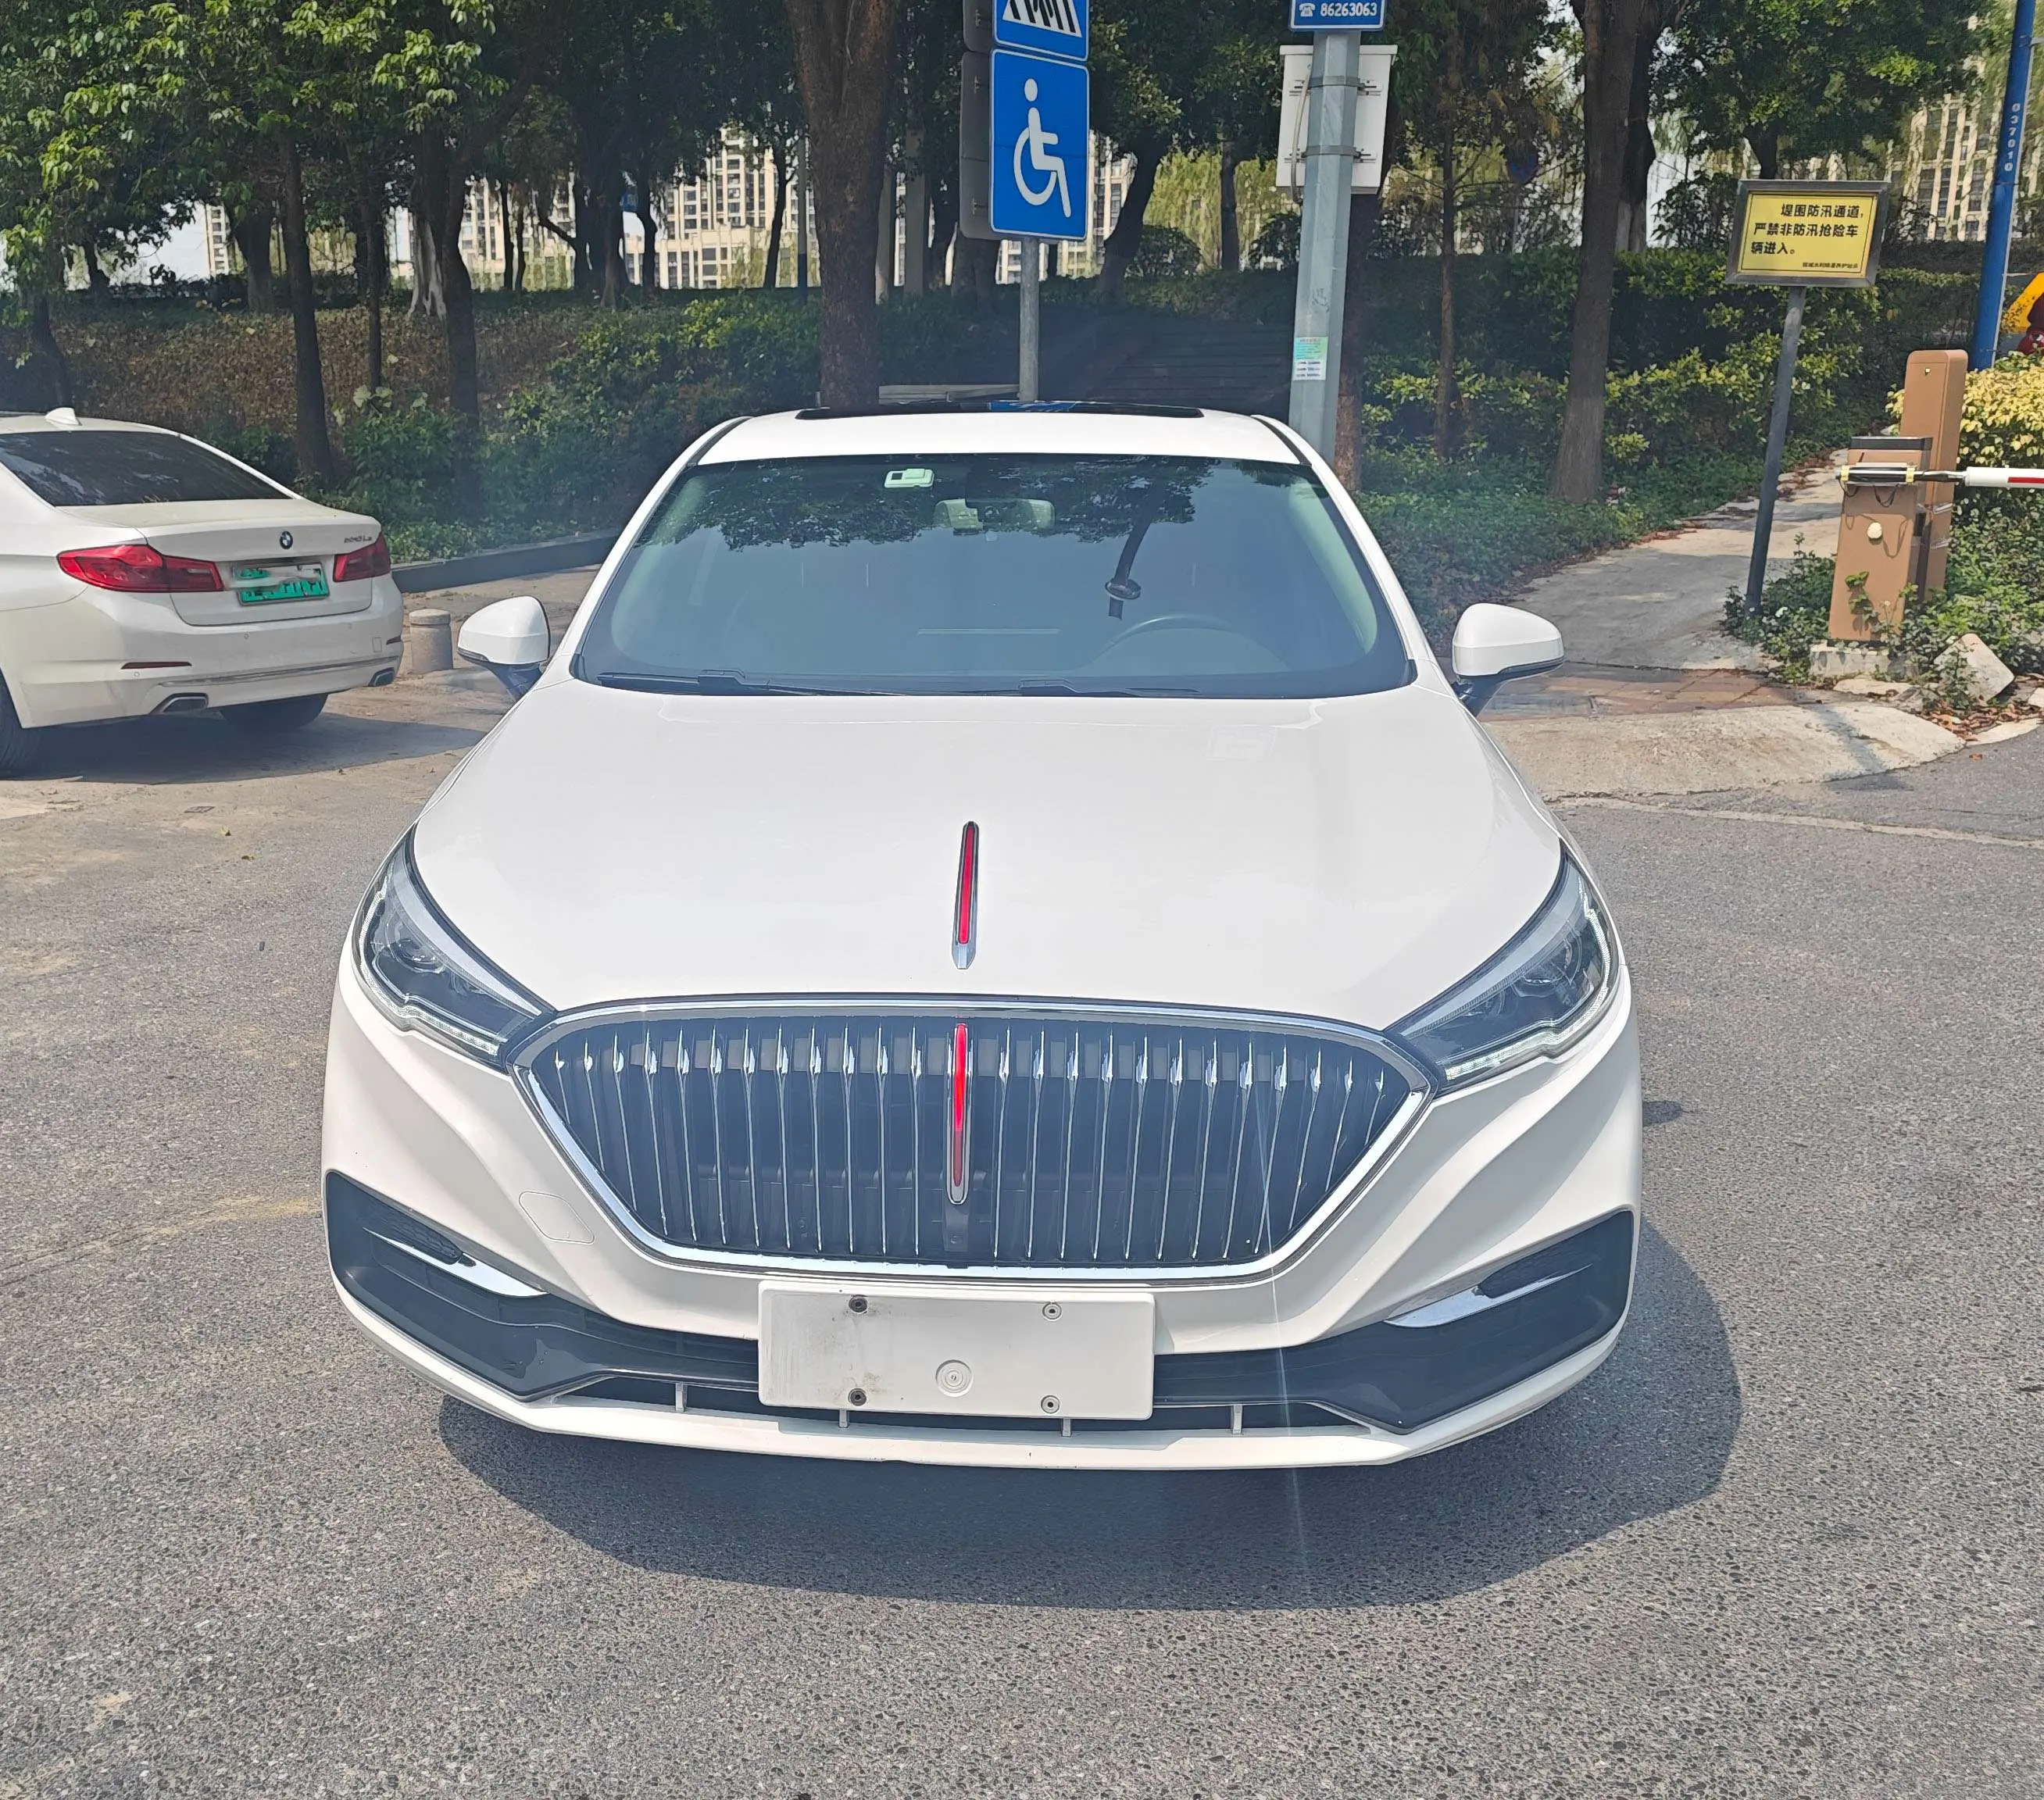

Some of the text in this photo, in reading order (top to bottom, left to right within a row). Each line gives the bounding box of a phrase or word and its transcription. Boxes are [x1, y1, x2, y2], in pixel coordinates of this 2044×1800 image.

[1320, 2, 1378, 16] 86263063
[1753, 222, 1859, 238] 严禁非防汛抢险车
